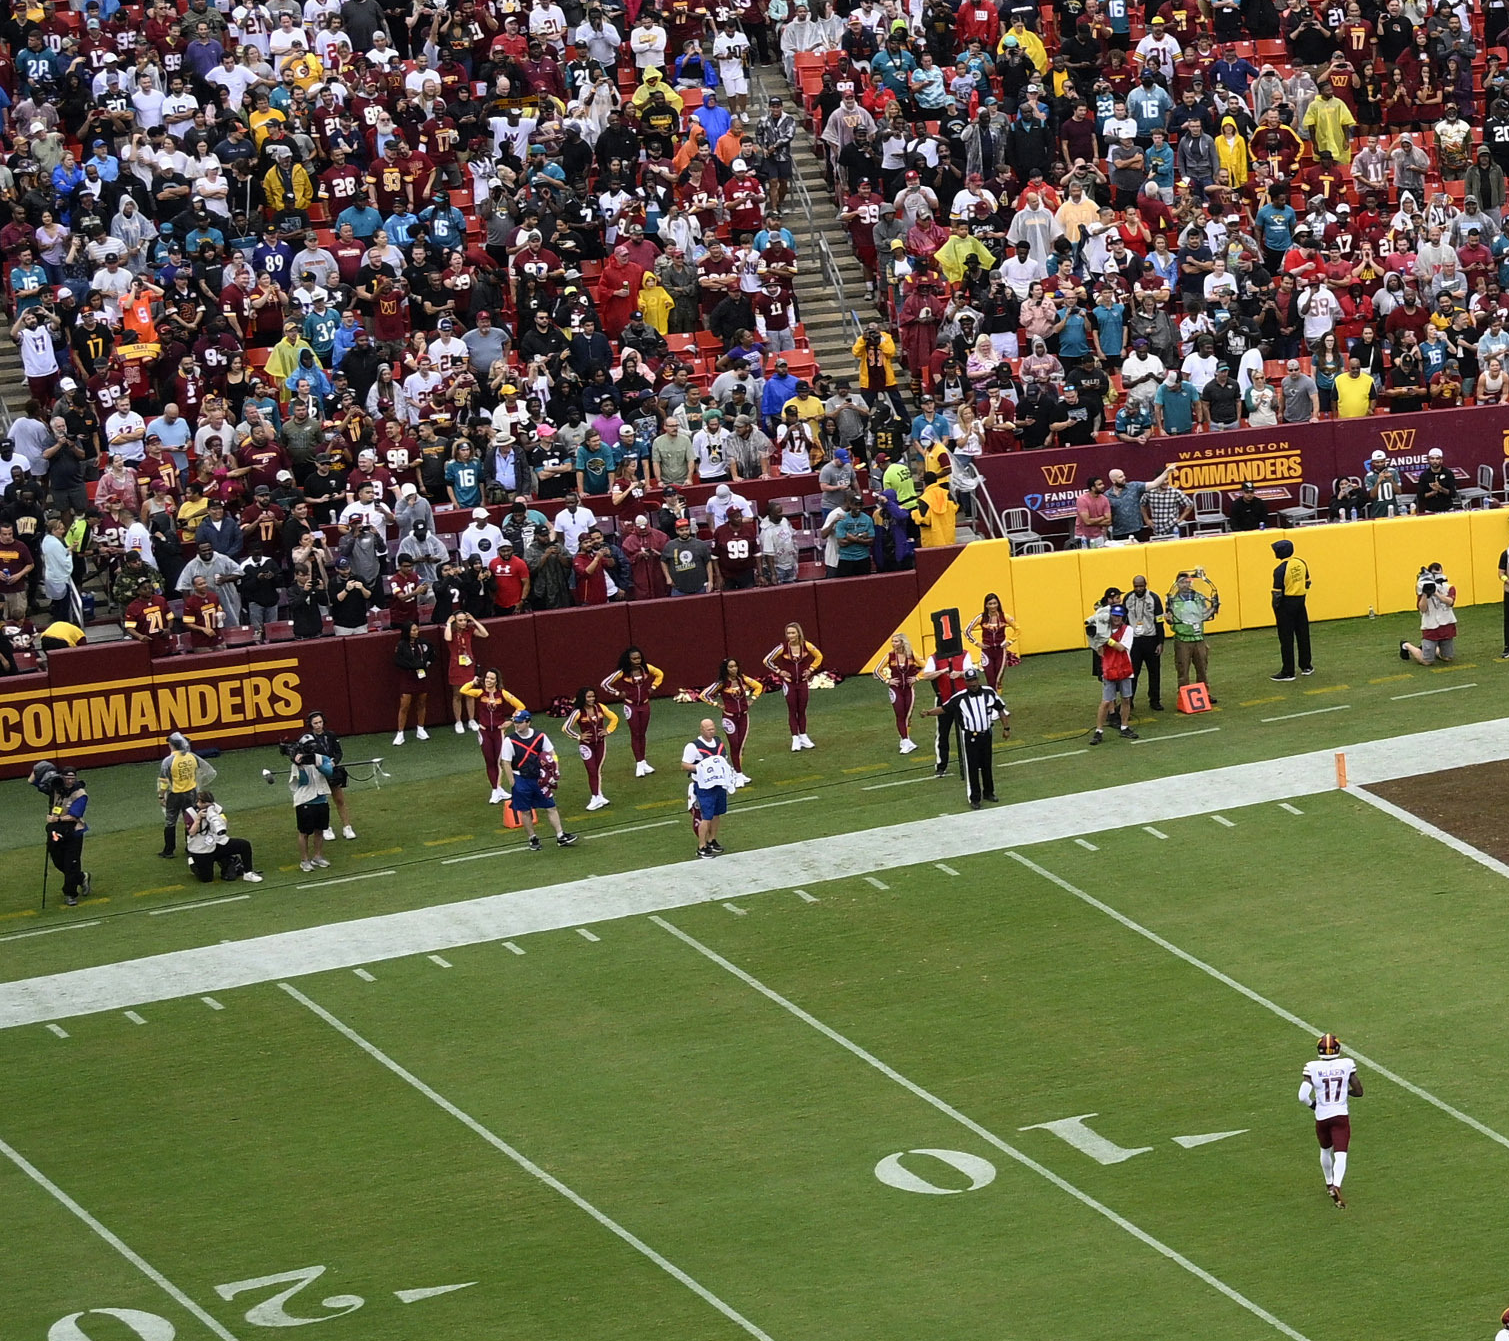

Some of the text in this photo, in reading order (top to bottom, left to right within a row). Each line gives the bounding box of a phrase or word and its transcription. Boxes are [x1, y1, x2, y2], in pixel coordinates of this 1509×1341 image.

[265, 255, 283, 271] 89
[1178, 442, 1289, 459] WASHINGTON
[1166, 456, 1302, 489] COMMANDERS
[941, 615, 953, 640] 1
[0, 671, 303, 750] COMMANDERS
[1187, 688, 1206, 711] G
[1321, 1077, 1344, 1103] 17
